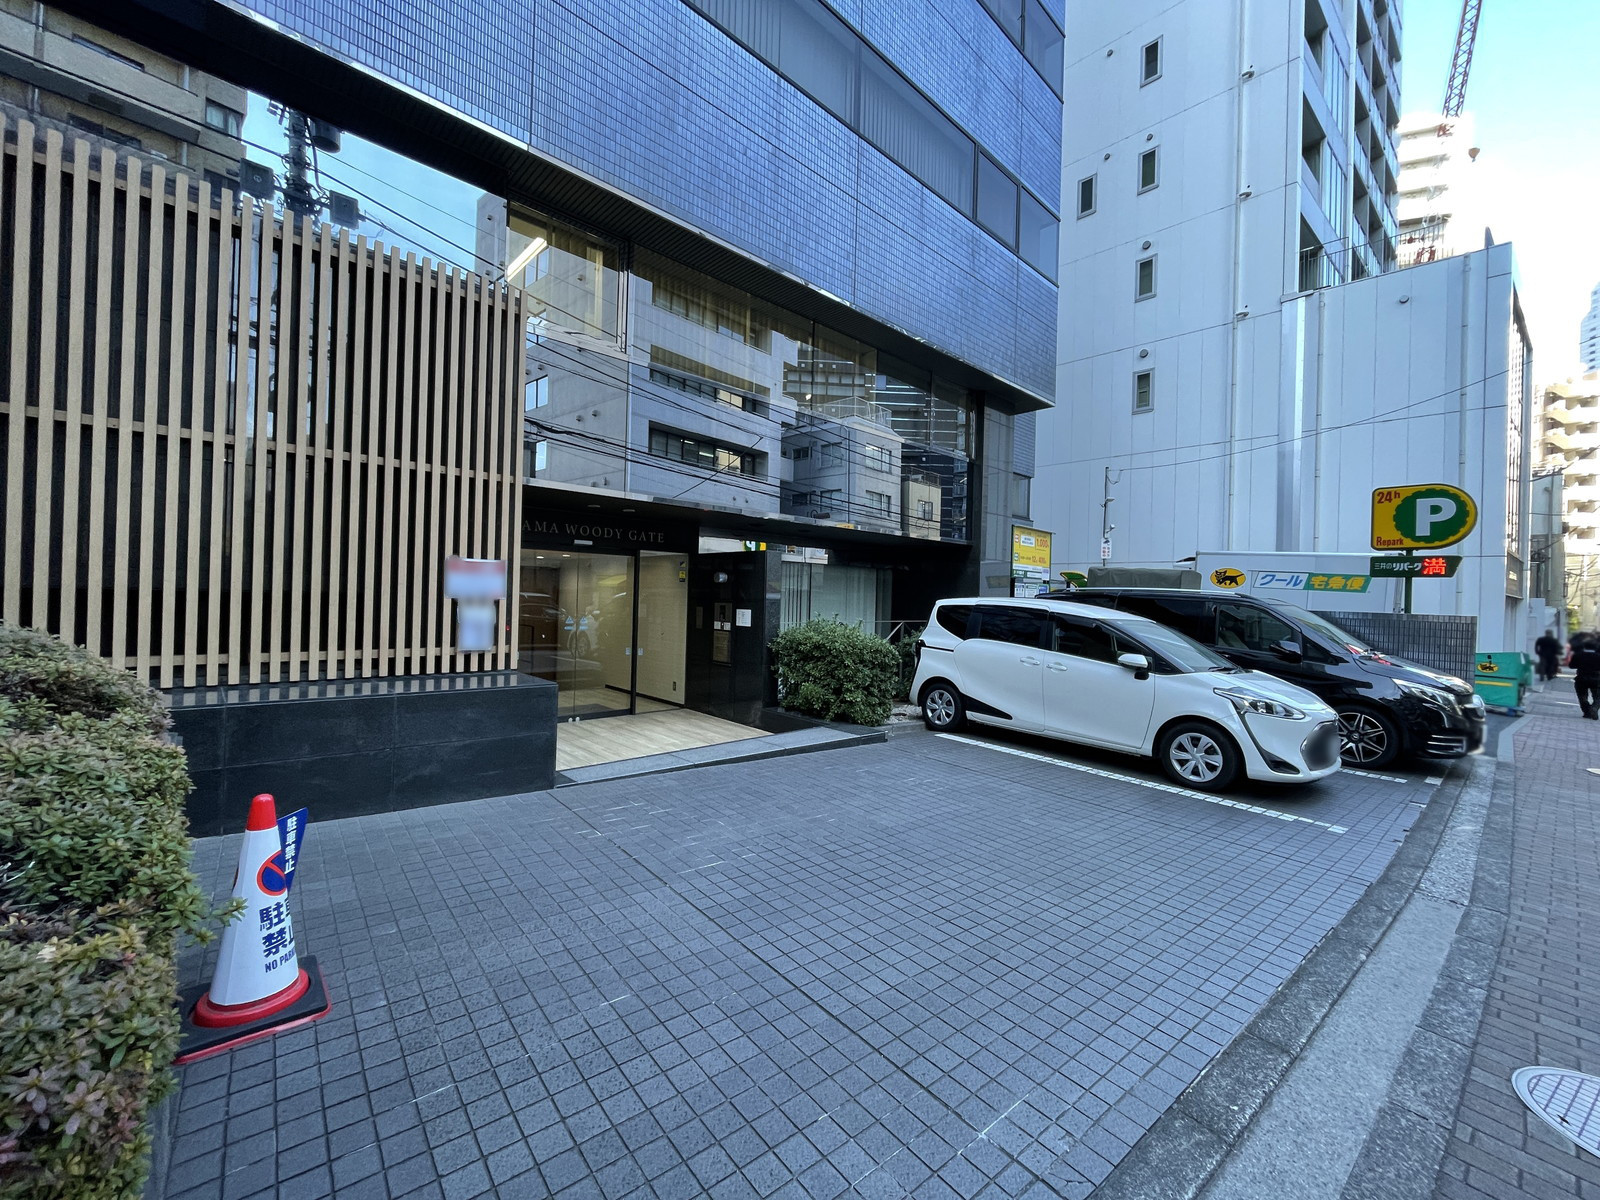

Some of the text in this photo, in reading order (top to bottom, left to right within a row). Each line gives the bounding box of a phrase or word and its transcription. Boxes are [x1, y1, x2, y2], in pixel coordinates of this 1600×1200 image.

[1376, 491, 1400, 504] 24h
[1415, 497, 1457, 537] P
[565, 523, 623, 540] WOODY
[628, 530, 665, 543] GATE
[1376, 536, 1404, 547] Repark
[1422, 557, 1447, 575] 満
[285, 816, 297, 874] 駐車禁止
[264, 959, 278, 973] NO
